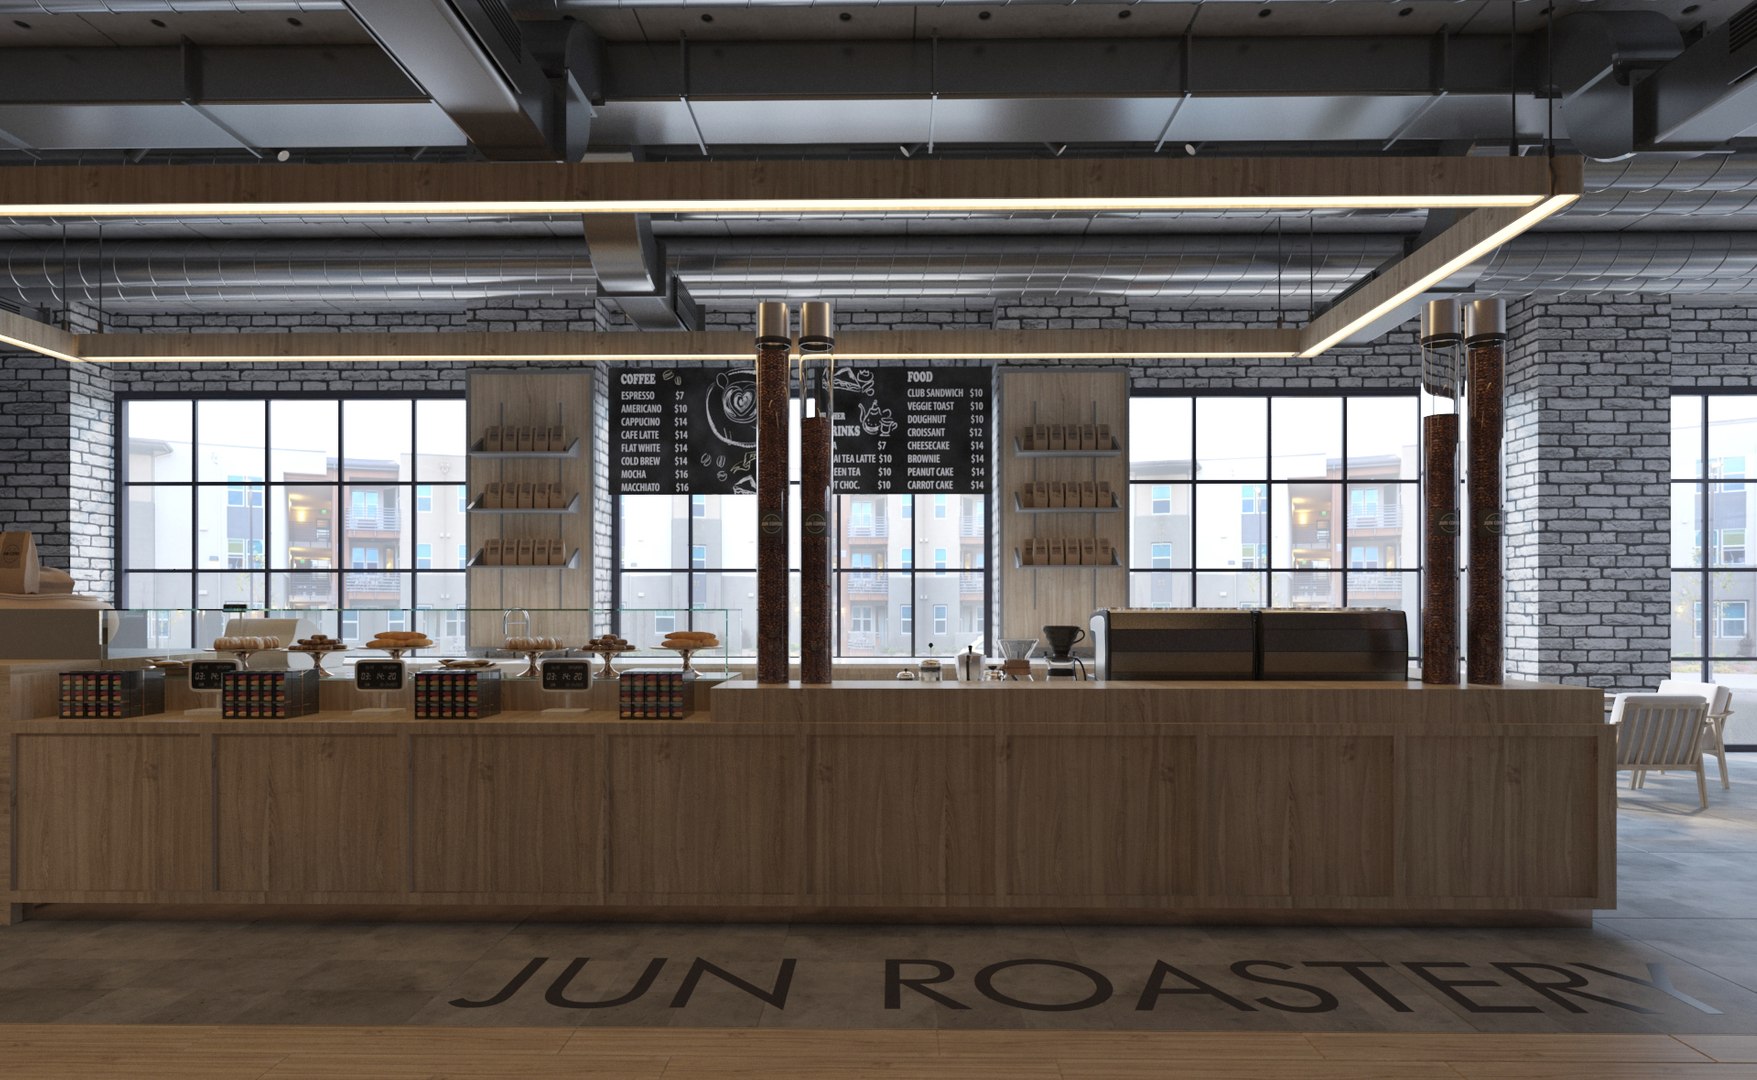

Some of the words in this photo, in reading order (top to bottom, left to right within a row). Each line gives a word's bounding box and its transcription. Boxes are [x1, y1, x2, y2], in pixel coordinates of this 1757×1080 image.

[621, 374, 656, 384] COFFEE
[908, 371, 933, 382] FOOD
[621, 391, 654, 400] ESPRESSO
[676, 391, 684, 400] $7
[908, 389, 925, 397] CLUB
[926, 389, 963, 397] SANDWICH
[970, 389, 983, 397] $10
[621, 404, 661, 413] AMERICANO
[675, 404, 687, 413] $10
[907, 402, 932, 410] VEGGIE
[933, 402, 954, 410] TOAST
[971, 402, 983, 411] $10
[621, 418, 660, 426] CAPPUCINO
[675, 417, 687, 427] $14
[908, 415, 946, 423] DOUGHNUT
[971, 415, 983, 424] $10
[621, 431, 638, 439] CAFE
[639, 431, 659, 439] LATTE
[675, 430, 688, 439] $14
[833, 425, 861, 437] RINKS
[908, 428, 945, 437] CROISSANT
[970, 428, 982, 437] $12
[621, 444, 637, 452] FLAT
[638, 444, 660, 452] WHITE
[675, 443, 688, 452] $14
[878, 441, 886, 450] $7
[908, 441, 950, 450] CHEESECAKE
[971, 441, 983, 450] $14
[621, 457, 639, 465] COLD
[640, 457, 660, 465] BREW
[675, 456, 687, 466] $14
[842, 454, 854, 463] TEA
[856, 454, 876, 463] LATTE
[879, 454, 892, 463] $10
[908, 454, 940, 463] BROWNIE
[971, 454, 984, 463] $14
[621, 470, 646, 478] MOCHA
[675, 469, 688, 479] $16
[848, 467, 861, 476] TEA
[879, 467, 891, 476] $10
[908, 468, 935, 476] PEANUT
[936, 467, 953, 476] CAKE
[972, 467, 984, 476] $14
[621, 483, 660, 491] MACCHIATO
[676, 483, 689, 492] $16
[839, 481, 860, 489] CHOC.
[878, 480, 891, 490] $10
[907, 481, 934, 489] CARROT
[936, 481, 953, 489] CAKE
[971, 480, 984, 490] $14
[448, 957, 797, 1010] JUN
[884, 958, 1725, 1014] ROASTERY
